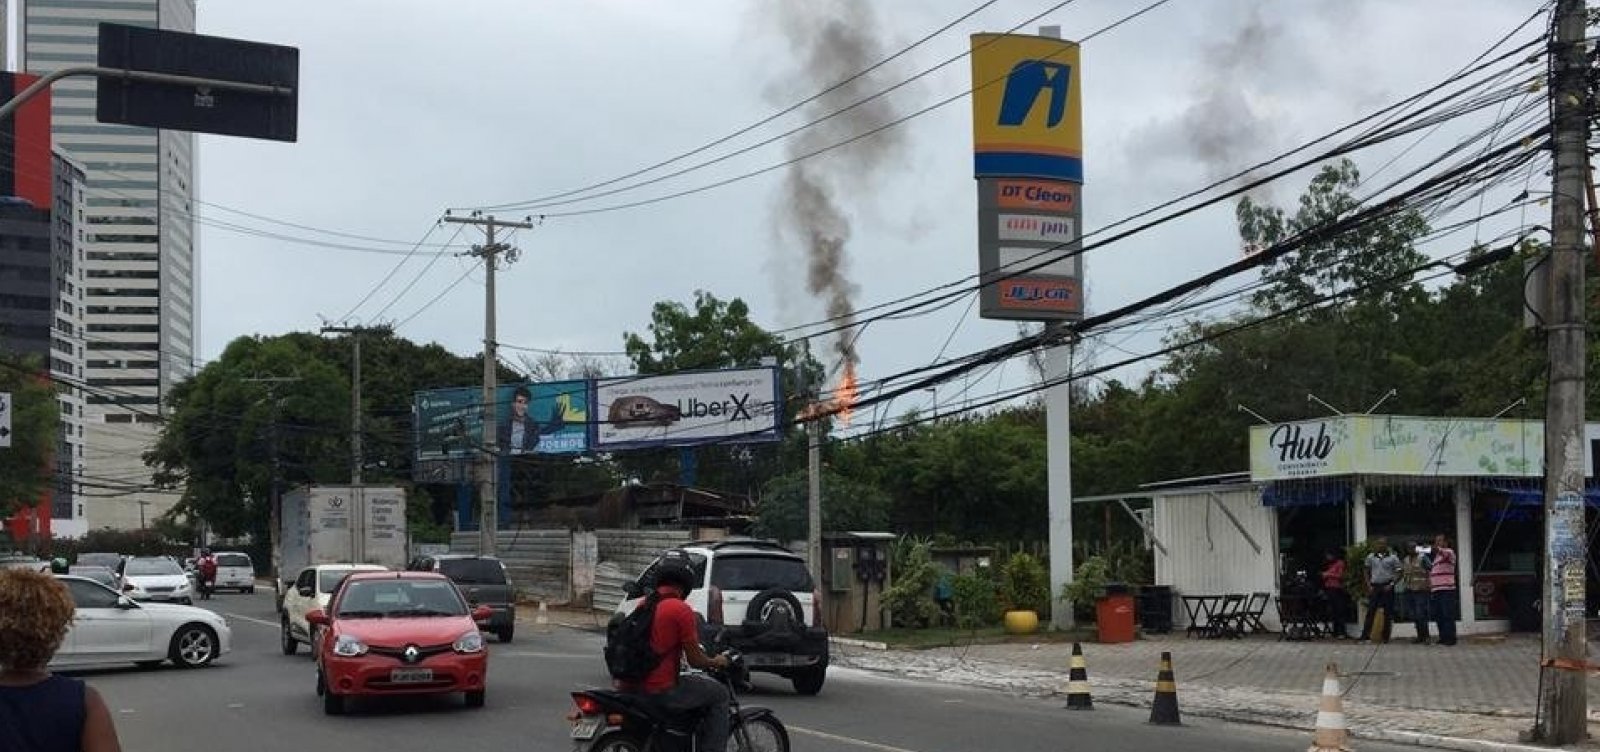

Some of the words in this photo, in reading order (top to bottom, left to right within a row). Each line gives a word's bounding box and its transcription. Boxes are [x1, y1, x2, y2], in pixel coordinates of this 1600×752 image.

[1025, 186, 1072, 204] Clean
[678, 393, 751, 421] UberX
[1269, 422, 1335, 461] Hub
